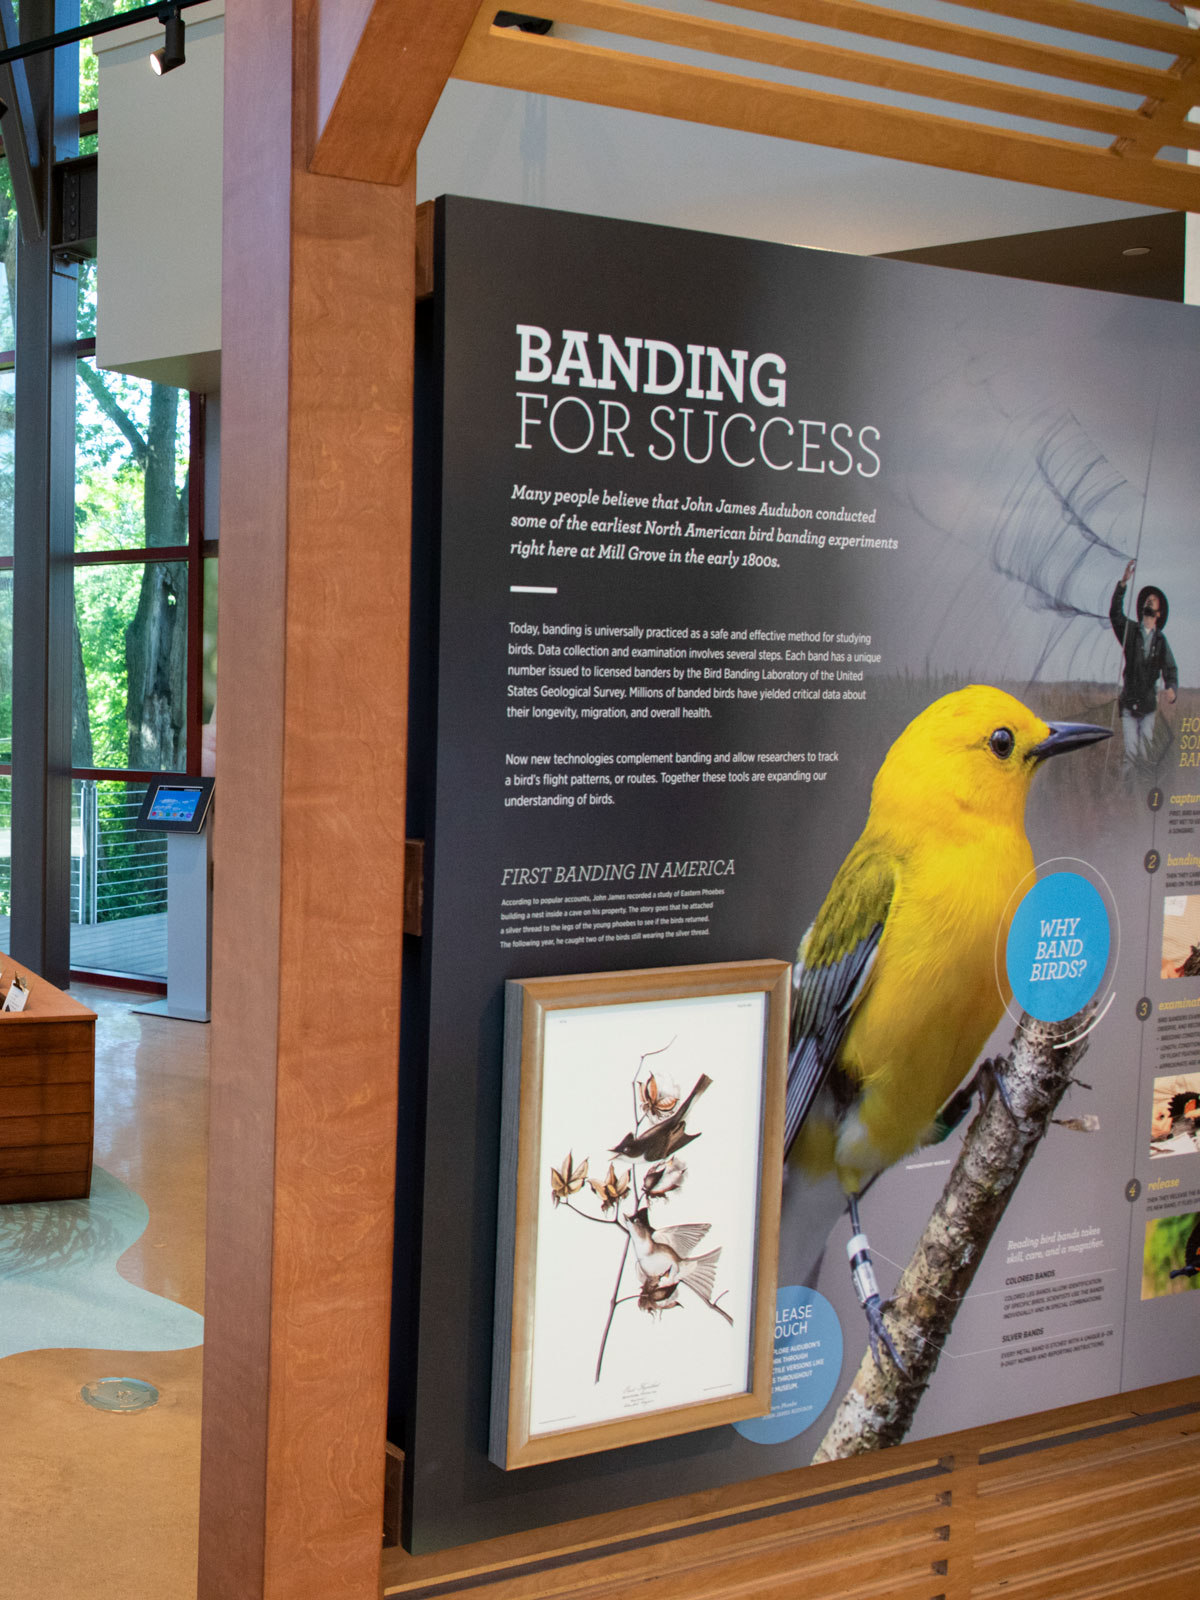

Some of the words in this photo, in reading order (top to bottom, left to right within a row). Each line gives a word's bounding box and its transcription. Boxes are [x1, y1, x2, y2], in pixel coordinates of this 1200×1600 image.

[515, 324, 787, 408] BANDING
[515, 391, 635, 458] FOR
[648, 405, 881, 478] SUCCESS
[510, 484, 552, 505] Many
[552, 488, 600, 507] people
[601, 489, 649, 508] believe
[651, 493, 680, 510] that
[680, 495, 713, 512] John
[715, 498, 757, 515] James
[757, 501, 813, 519] Audubon
[815, 506, 877, 523] conducted
[510, 515, 547, 529] some
[549, 514, 566, 529] of
[565, 515, 588, 531] the
[590, 517, 642, 534] earliest
[643, 520, 682, 536] North
[683, 522, 746, 540] American
[748, 525, 775, 542] bird
[775, 527, 826, 548] banding
[827, 535, 899, 550] experiments
[509, 540, 546, 559] right
[546, 541, 578, 558] here
[579, 545, 596, 558] at
[596, 544, 626, 560] Mill
[627, 545, 667, 562] Grove
[668, 548, 682, 563] in
[684, 548, 705, 564] the
[706, 549, 740, 569] early
[741, 552, 780, 568] 1800s.
[508, 621, 540, 636] Today,
[542, 623, 582, 638] banding
[584, 624, 592, 636] is
[594, 625, 644, 639] universally
[645, 626, 689, 639] practiced
[690, 629, 701, 639] as
[702, 629, 709, 639] a
[710, 628, 729, 640] safe
[730, 629, 748, 640] and
[748, 629, 786, 641] effective
[787, 631, 821, 642] method
[822, 631, 835, 643] for
[836, 632, 872, 646] studying
[507, 642, 535, 655] birds.
[537, 643, 561, 656] Data
[562, 644, 609, 657] collection
[610, 645, 629, 657] and
[631, 646, 687, 658] examination
[688, 647, 725, 659] involves
[726, 648, 757, 660] several
[758, 649, 783, 662] steps.
[785, 649, 806, 661] Each
[807, 650, 829, 662] band
[830, 651, 845, 662] has
[846, 653, 852, 662] a
[853, 651, 882, 664] unique
[507, 664, 546, 676] number
[548, 664, 579, 677] issued
[581, 665, 592, 677] to
[593, 665, 632, 678] licensed
[633, 666, 671, 678] banders
[672, 666, 685, 680] by
[686, 667, 702, 679] the
[703, 667, 722, 679] Bird
[723, 667, 760, 681] Banding
[761, 668, 808, 682] Laboratory
[809, 669, 819, 680] of
[820, 669, 835, 681] the
[836, 669, 864, 681] United
[507, 684, 538, 697] States
[540, 685, 591, 699] Geological
[593, 685, 627, 700] Survey.
[629, 686, 664, 698] Millions
[665, 686, 676, 698] of
[677, 687, 711, 699] banded
[712, 687, 735, 699] birds
[736, 687, 758, 699] have
[759, 688, 791, 701] yielded
[792, 688, 821, 700] critical
[821, 688, 841, 700] data
[841, 689, 867, 700] about
[506, 705, 530, 718] their
[532, 705, 579, 720] longevity,
[580, 706, 628, 720] migration,
[630, 706, 649, 718] and
[650, 706, 681, 718] overall
[682, 706, 712, 718] health.
[505, 753, 529, 765] Now
[530, 755, 551, 765] new
[553, 752, 614, 766] technologies
[615, 752, 673, 765] complement
[675, 751, 712, 765] banding
[713, 751, 731, 763] and
[731, 751, 755, 763] allow
[757, 751, 806, 762] researchers
[806, 751, 816, 762] to
[817, 750, 839, 762] track
[504, 776, 512, 786] a
[513, 773, 541, 786] bird's
[542, 773, 568, 787] flight
[570, 773, 612, 786] patterns,
[614, 774, 625, 784] or
[626, 773, 658, 784] routes.
[660, 771, 700, 785] Together
[702, 771, 727, 783] these
[728, 771, 750, 782] tools
[751, 772, 766, 782] are
[766, 770, 811, 783] expanding
[812, 771, 827, 781] our
[504, 794, 575, 807] understanding
[576, 793, 588, 805] of
[588, 793, 615, 805] birds.
[1152, 792, 1158, 806] 1
[1148, 854, 1156, 868] 2
[500, 866, 552, 886] FIRST
[553, 863, 636, 883] BANDING
[637, 862, 660, 879] IN
[660, 859, 735, 878] AMERICA
[1040, 918, 1081, 938] WHY
[1035, 939, 1083, 960] BAND
[1029, 960, 1087, 981] BIRDS?
[1140, 1002, 1148, 1016] 3
[1128, 1183, 1136, 1196] 4
[1148, 1177, 1180, 1191] release
[1007, 1237, 1039, 1250] Reading
[1040, 1232, 1056, 1244] bird
[1057, 1228, 1080, 1241] bands
[1081, 1226, 1100, 1237] takes
[1007, 1251, 1024, 1264] skill,
[1045, 1245, 1060, 1257] and
[1005, 1274, 1034, 1285] COLORED
[1035, 1269, 1055, 1280] BANDS
[776, 1304, 813, 1323] LEASE
[774, 1321, 808, 1339] OUCH
[1002, 1331, 1022, 1342] SILVER
[1023, 1327, 1044, 1338] BANDS
